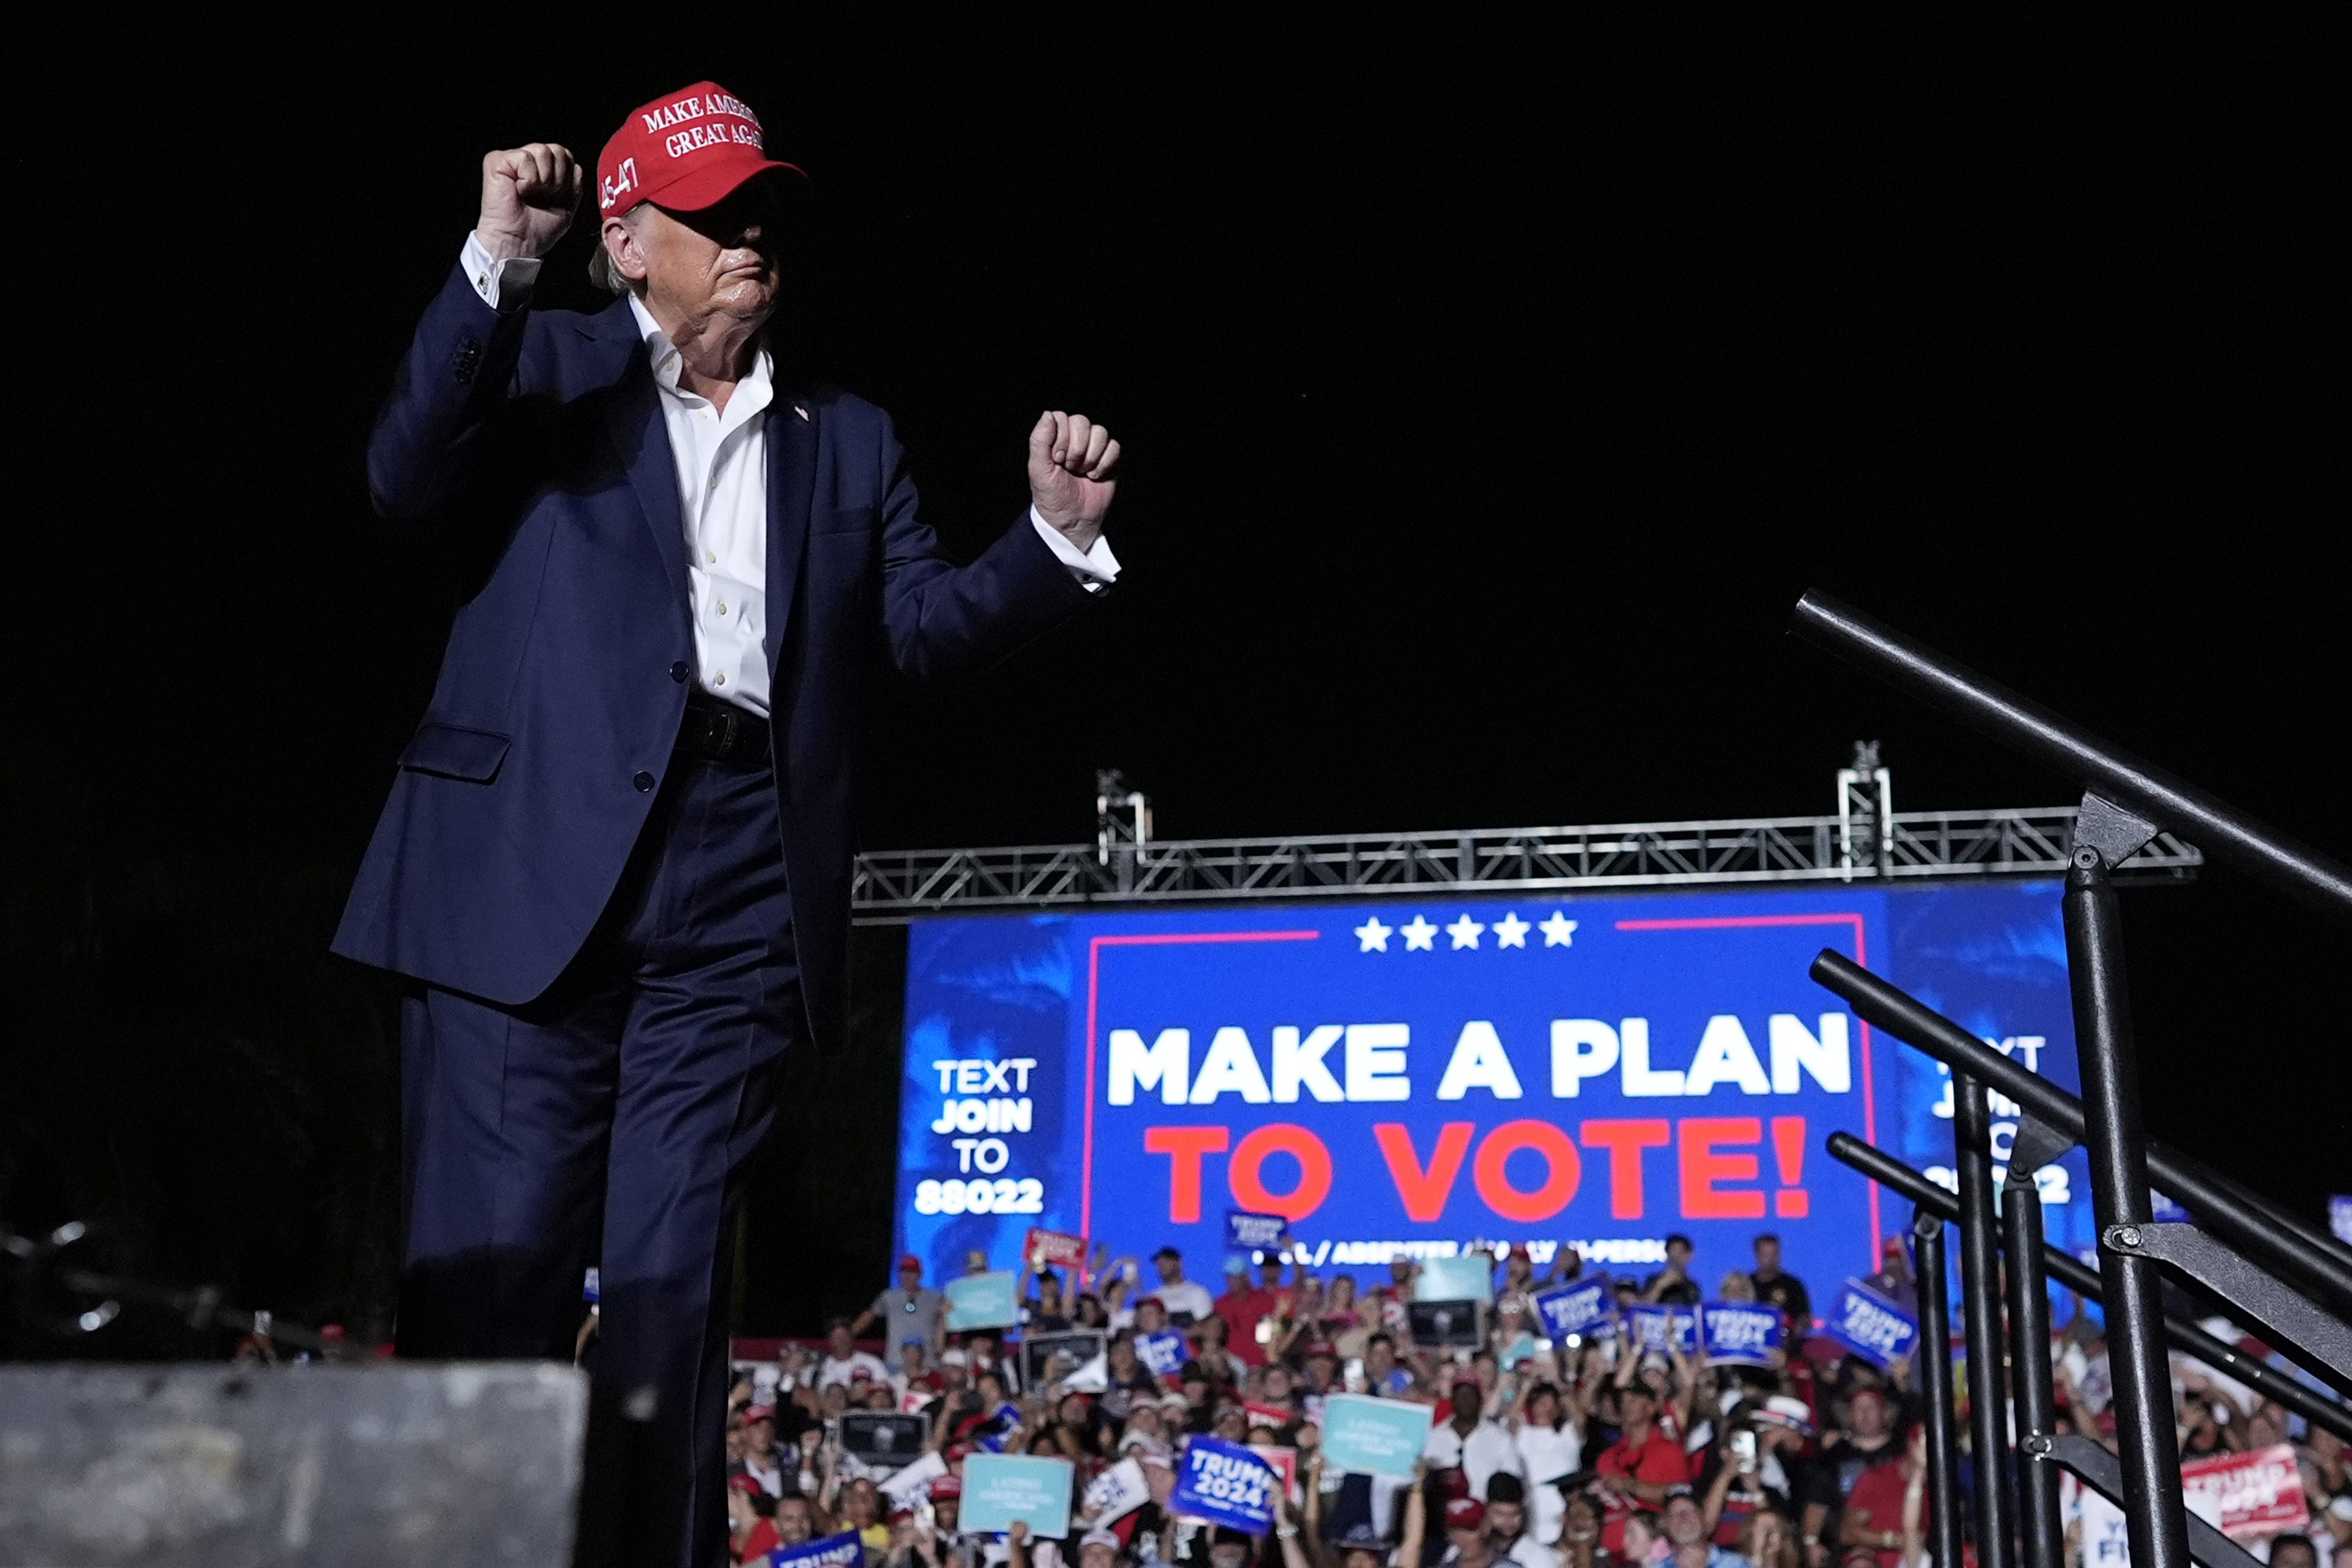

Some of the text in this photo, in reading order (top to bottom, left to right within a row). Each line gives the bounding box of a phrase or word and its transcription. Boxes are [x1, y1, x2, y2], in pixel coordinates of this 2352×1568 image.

[642, 97, 704, 134] MAKE
[666, 123, 730, 158] GREAT
[932, 1058, 1038, 1094] TEXT
[1107, 1023, 1411, 1106] MAKE
[1436, 1020, 1523, 1100] A
[1550, 1012, 1851, 1098] PLAN
[931, 1097, 1033, 1135] JOIN
[952, 1137, 1010, 1174] TO
[1145, 1116, 1809, 1221] TO VOTE!
[914, 1178, 1044, 1216] 88022
[1194, 1472, 1263, 1507] 2024
